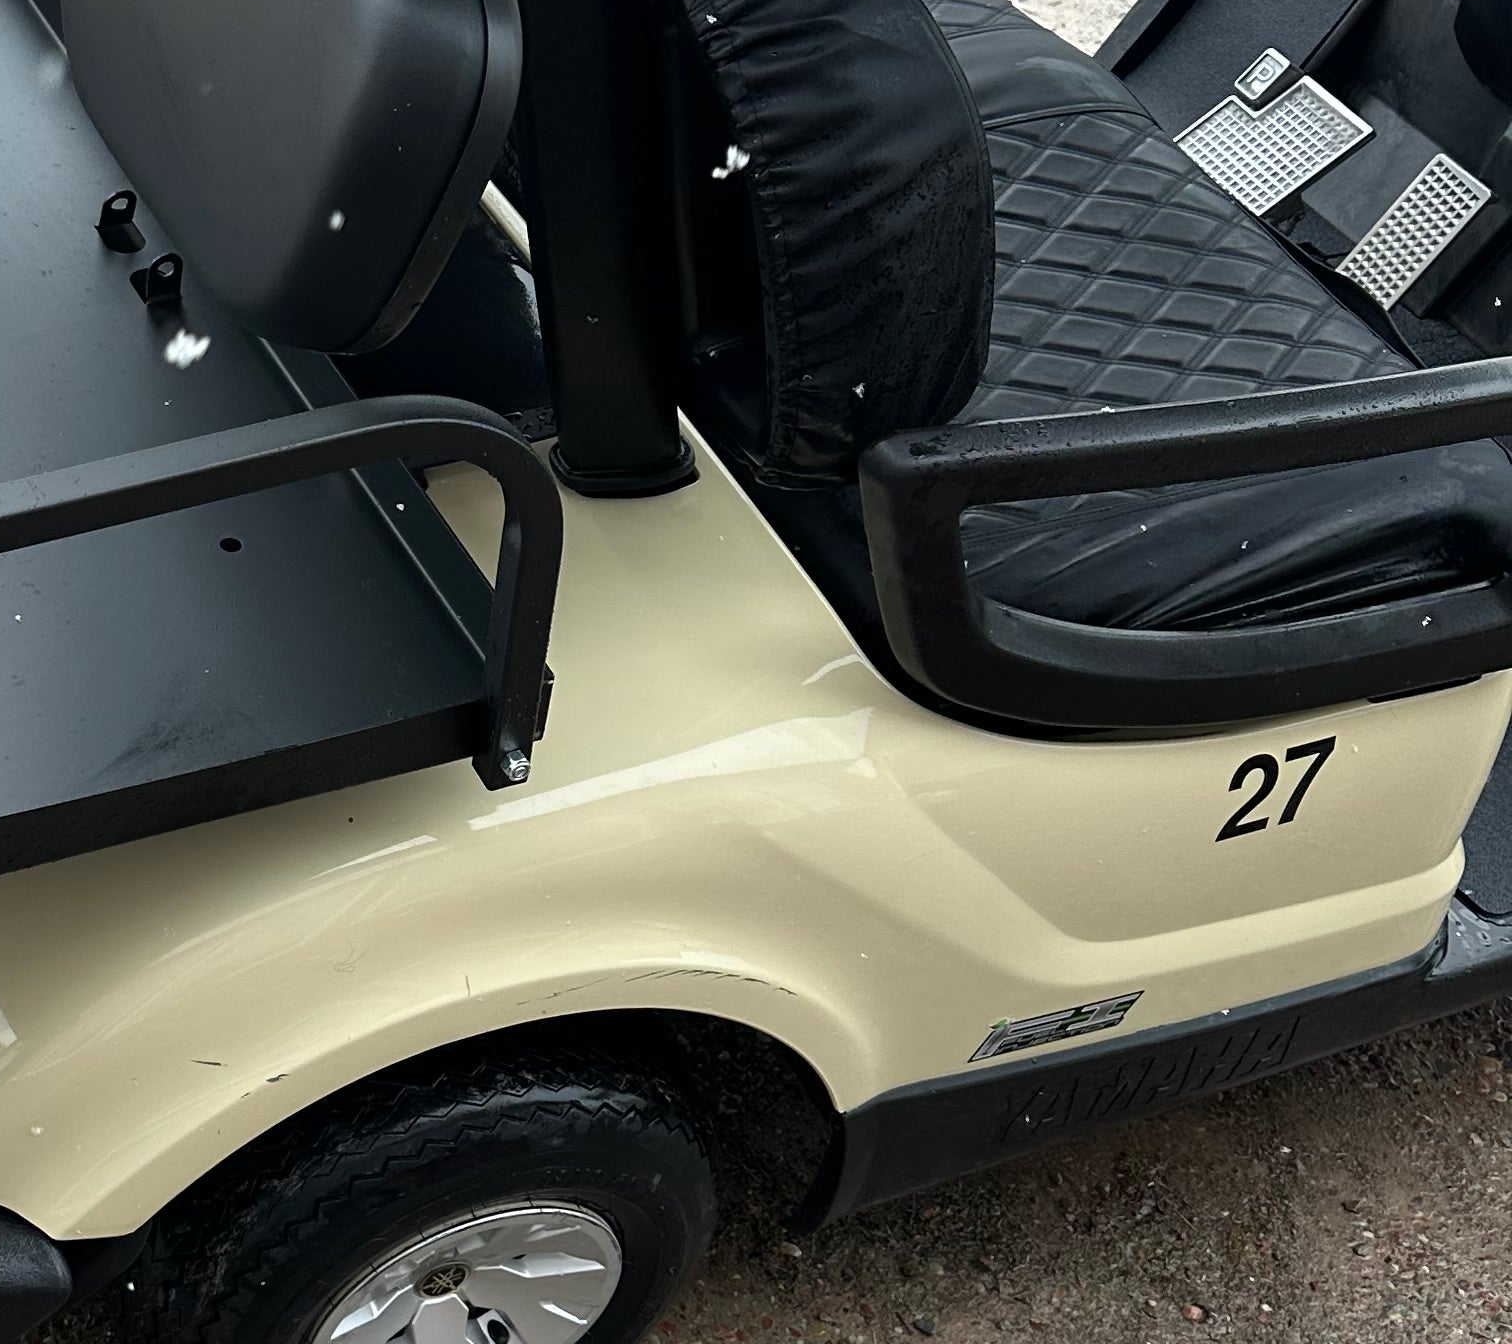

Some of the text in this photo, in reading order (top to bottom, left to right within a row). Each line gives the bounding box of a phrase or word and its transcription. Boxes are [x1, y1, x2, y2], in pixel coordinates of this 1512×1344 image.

[1246, 62, 1274, 83] P
[1214, 735, 1337, 843] 27
[1000, 1015, 1301, 1145] YAMAHA
